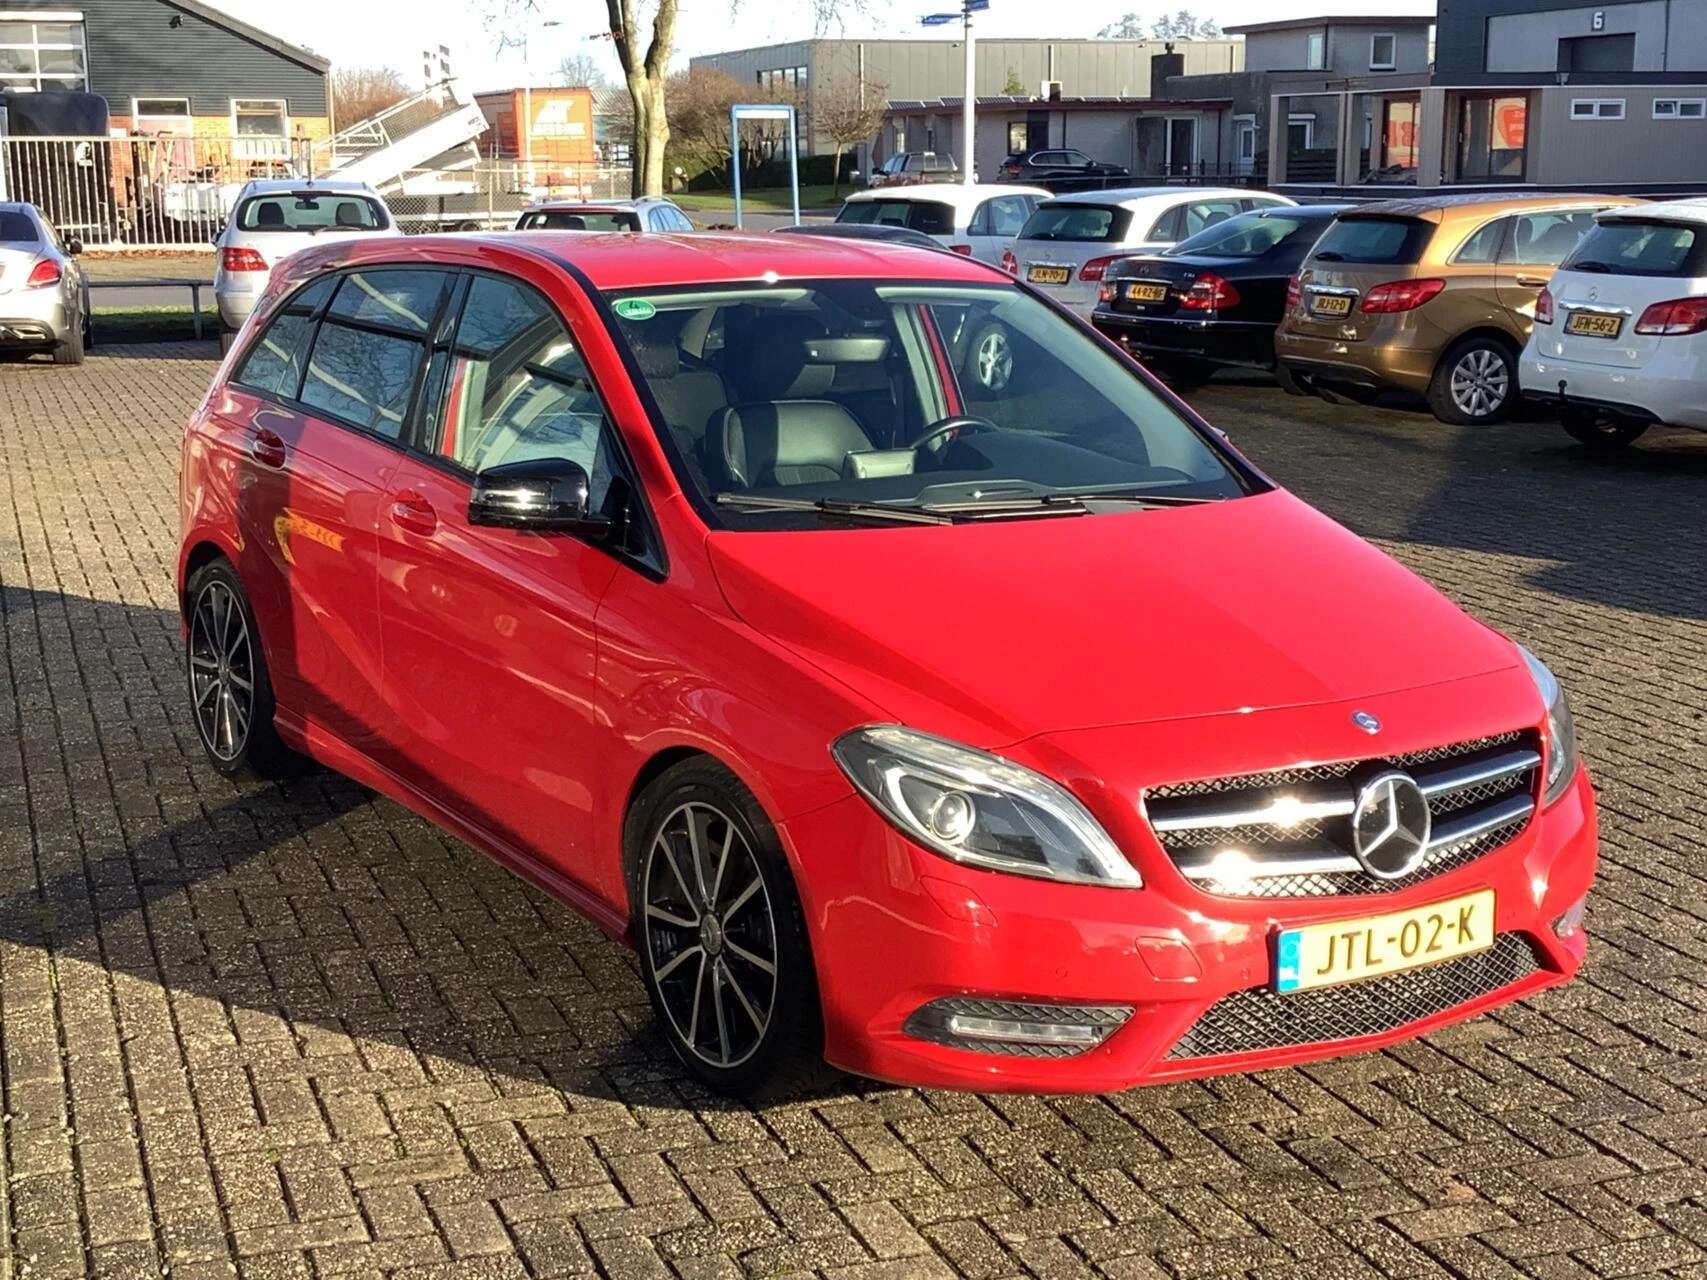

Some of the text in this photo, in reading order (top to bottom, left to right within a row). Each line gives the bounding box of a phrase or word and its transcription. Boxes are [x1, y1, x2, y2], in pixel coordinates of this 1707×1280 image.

[1594, 11, 1603, 29] 6
[1573, 316, 1617, 332] JFN-56-Z
[1317, 904, 1475, 976] JTL-02-K
